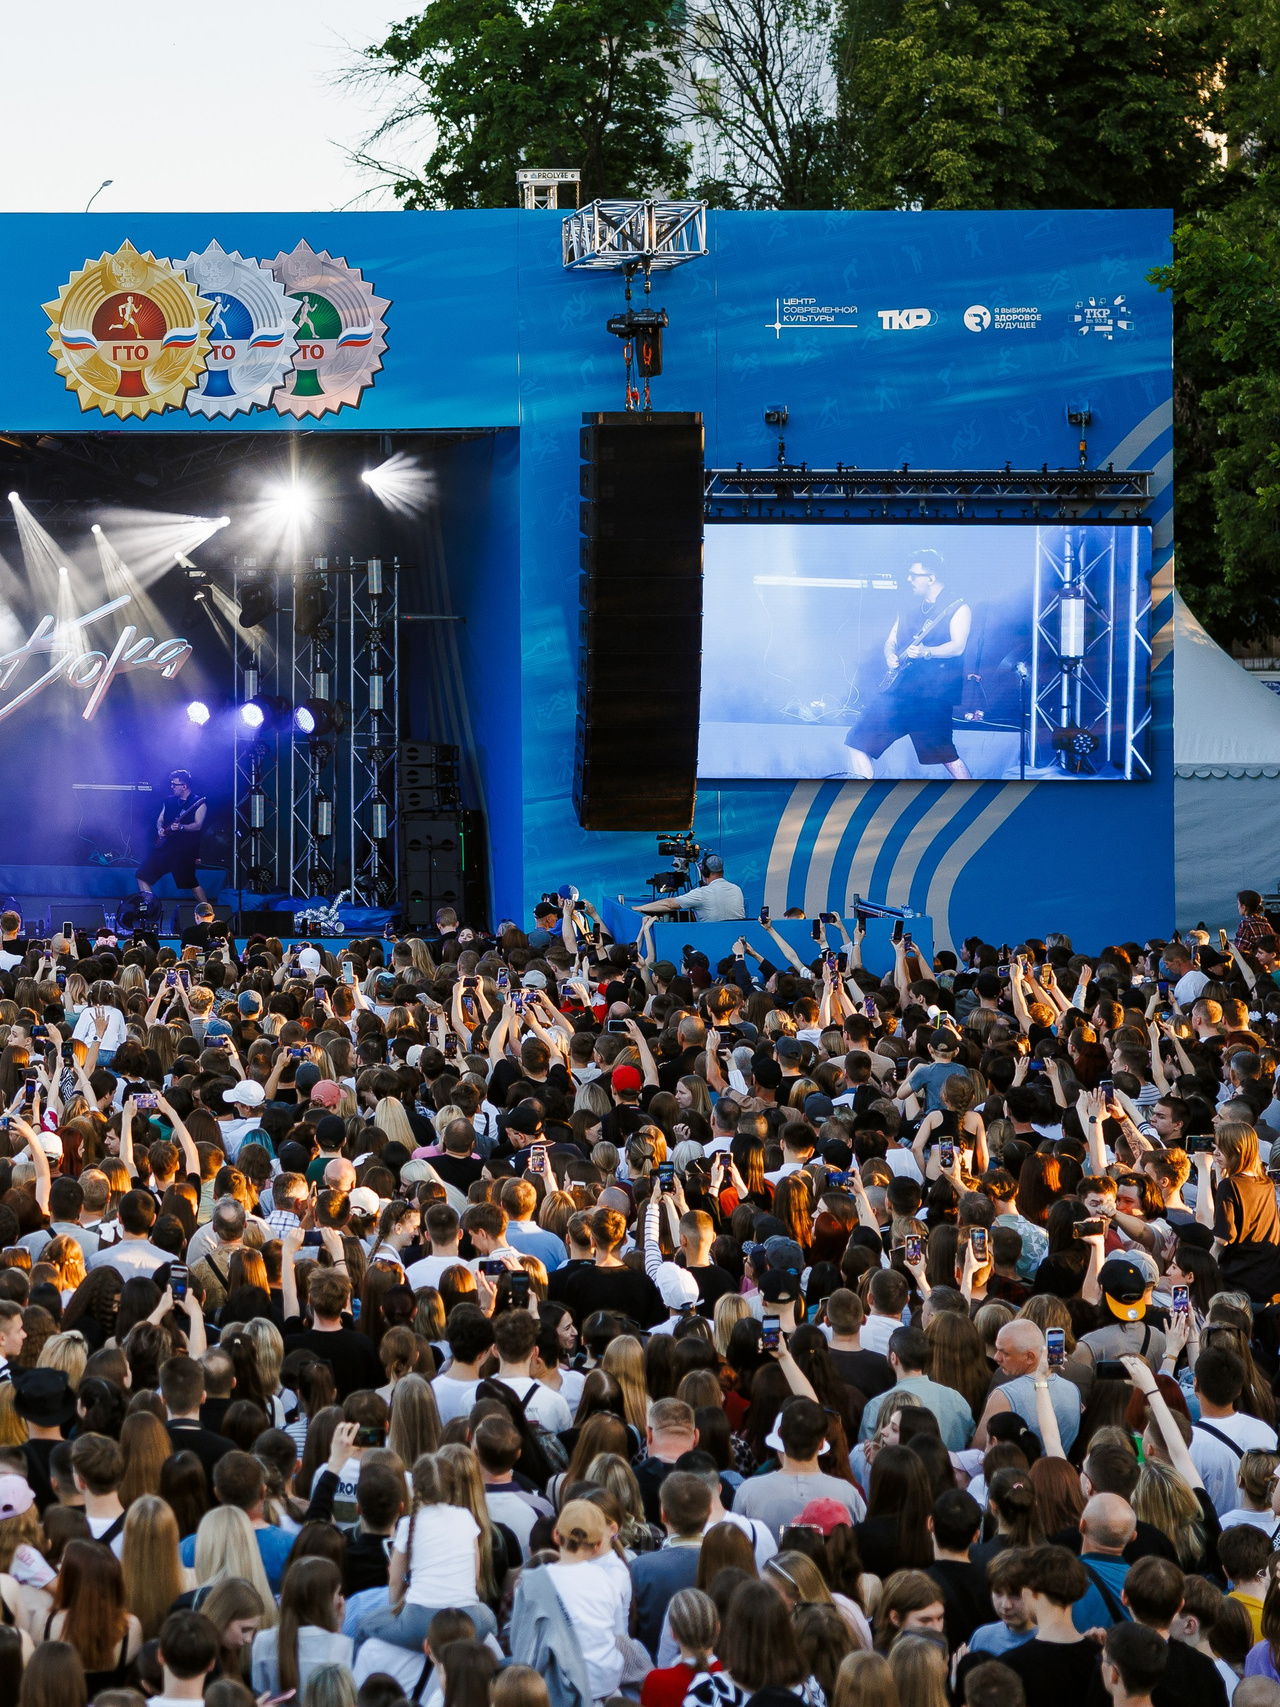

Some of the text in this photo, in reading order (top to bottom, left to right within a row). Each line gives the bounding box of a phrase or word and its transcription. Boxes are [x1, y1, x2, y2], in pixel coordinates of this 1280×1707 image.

[783, 298, 817, 306] ЦЕНТР
[783, 305, 858, 314] СОВРЕМЕННОЙ
[994, 314, 1042, 322] ЗДОРОВОЕ
[994, 322, 1037, 330] БУДУЩЕЕ
[112, 345, 149, 361] ГТО
[212, 345, 236, 360] ТО
[300, 345, 325, 360] ТО
